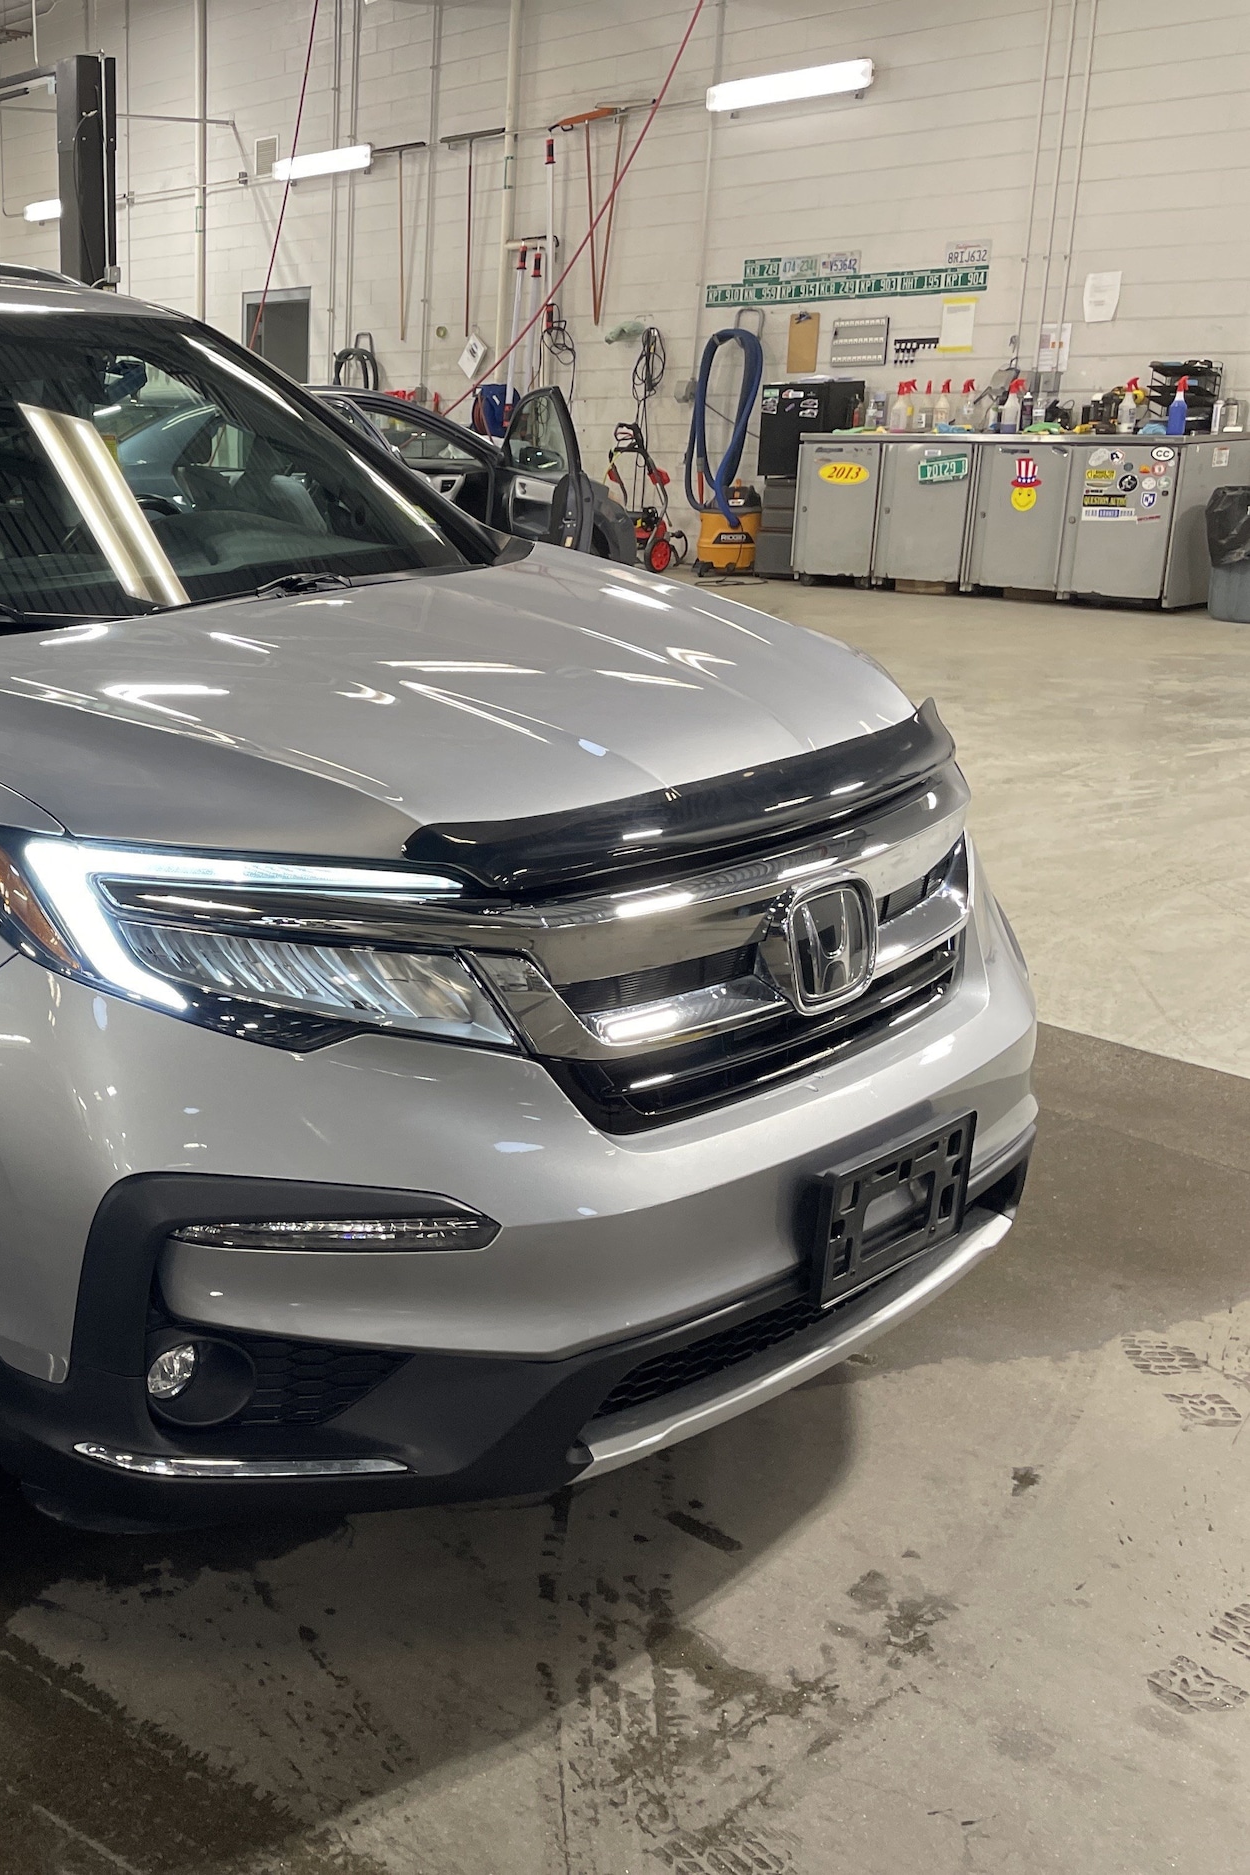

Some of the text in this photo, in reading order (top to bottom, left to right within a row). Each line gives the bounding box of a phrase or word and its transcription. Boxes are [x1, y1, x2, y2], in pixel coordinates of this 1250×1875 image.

[945, 272, 984, 287] KPT 904
[839, 281, 855, 294] 249
[1155, 449, 1170, 458] CC
[827, 466, 862, 480] 2013
